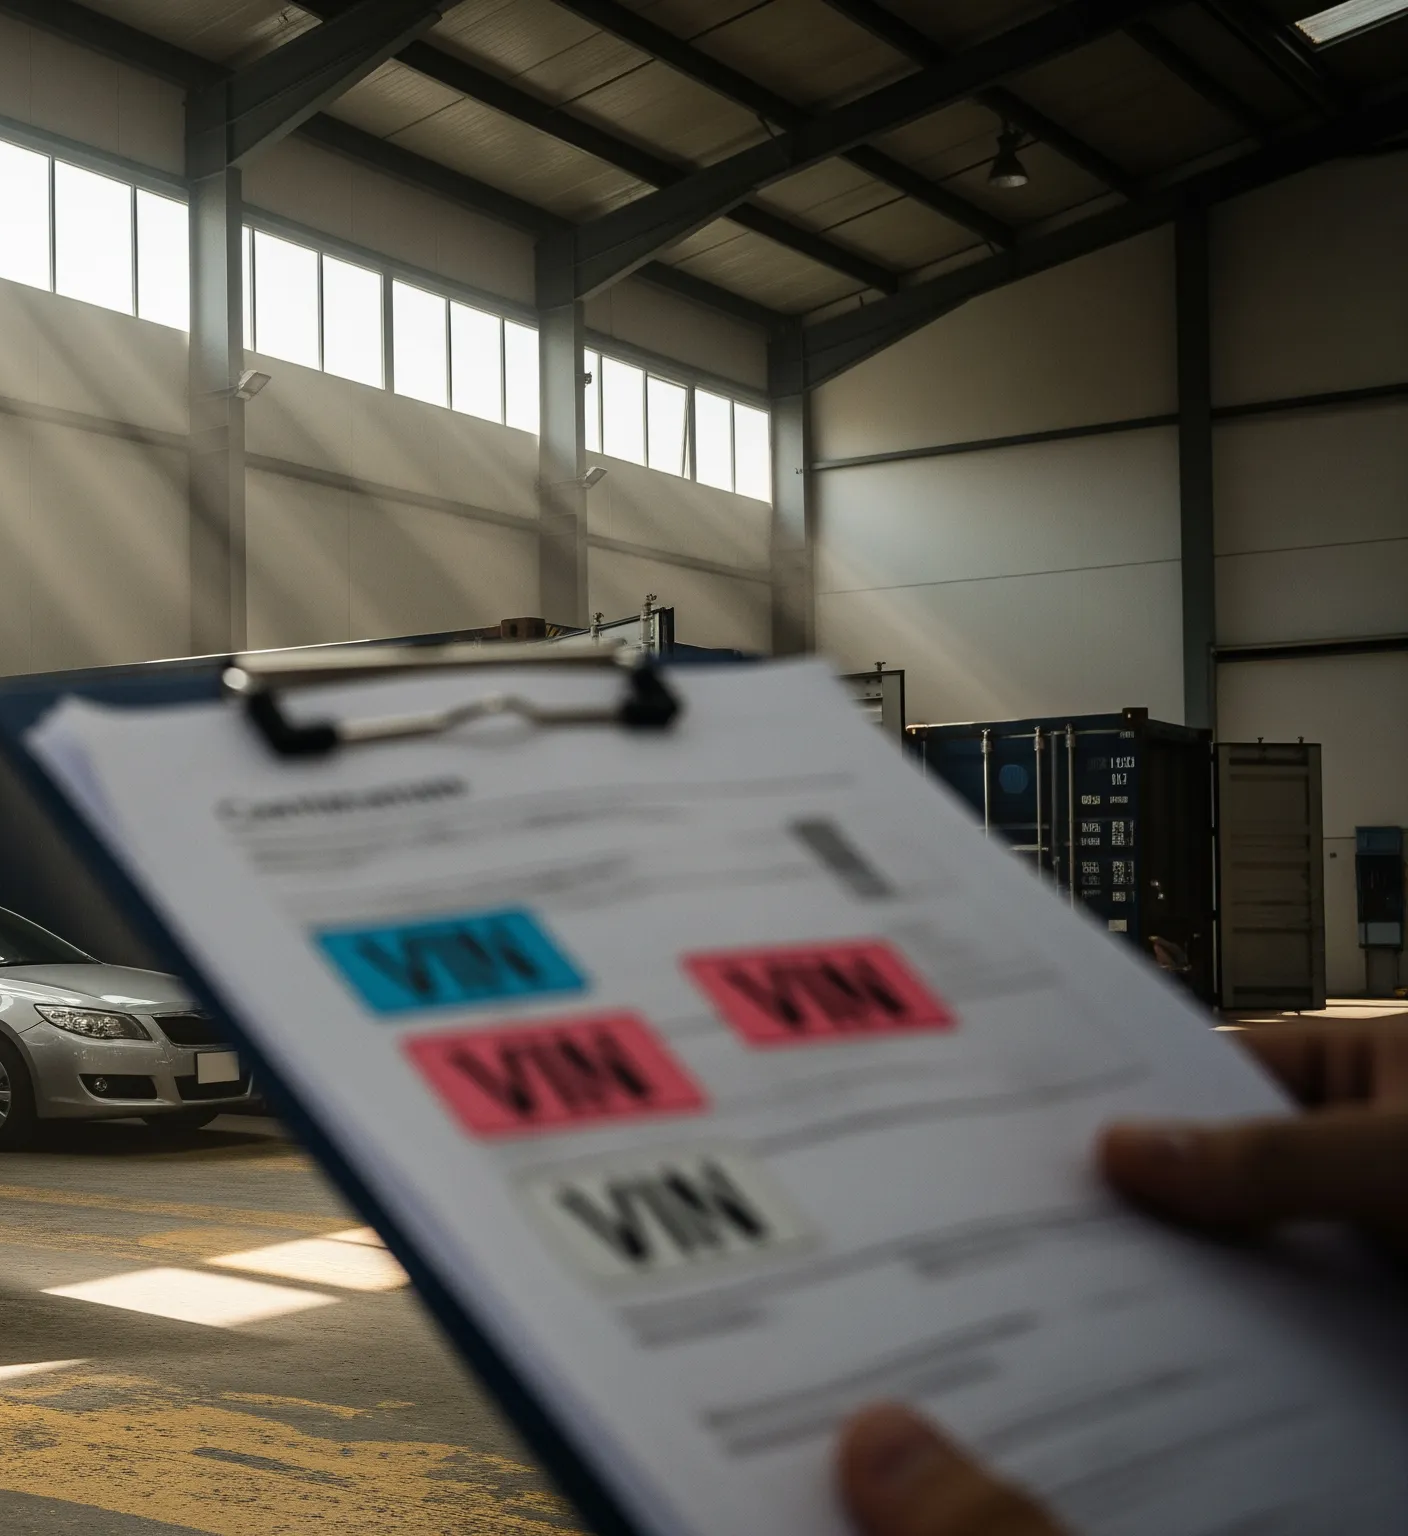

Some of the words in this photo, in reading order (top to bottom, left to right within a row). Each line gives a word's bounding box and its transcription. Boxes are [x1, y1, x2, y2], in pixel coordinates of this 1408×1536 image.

[353, 920, 542, 1002] VIN
[719, 953, 908, 1034] VIN
[448, 1025, 652, 1119] VIN
[555, 1158, 768, 1270] VIN
